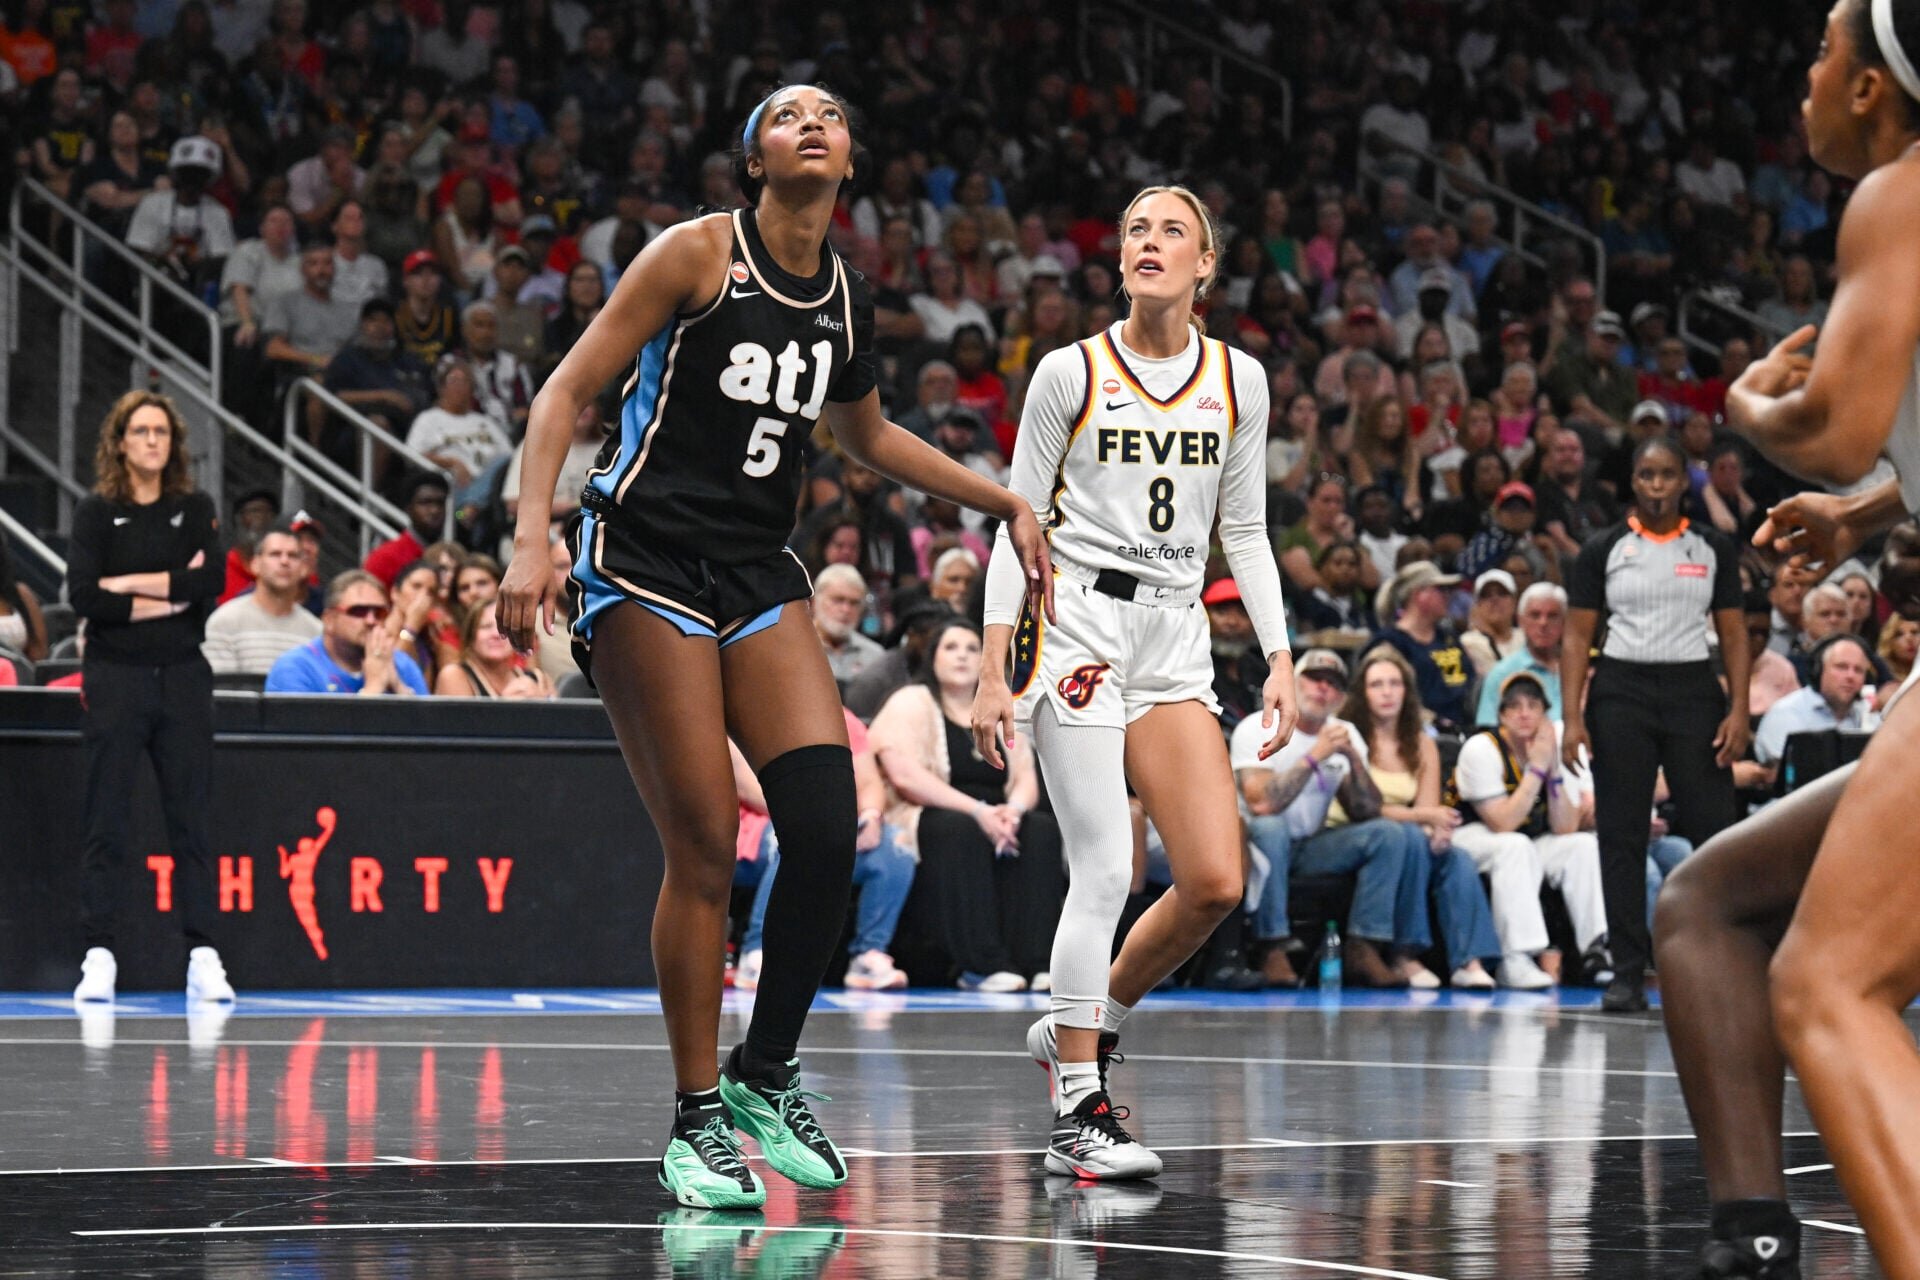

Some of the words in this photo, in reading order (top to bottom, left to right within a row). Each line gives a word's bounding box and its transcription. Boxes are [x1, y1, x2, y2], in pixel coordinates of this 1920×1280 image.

[814, 313, 844, 333] Albert
[719, 340, 833, 421] atl
[1196, 396, 1225, 414] Lilly
[742, 416, 789, 478] 5
[1097, 426, 1221, 466] FEVER
[1148, 475, 1175, 535] 8
[1117, 543, 1195, 561] salesforce
